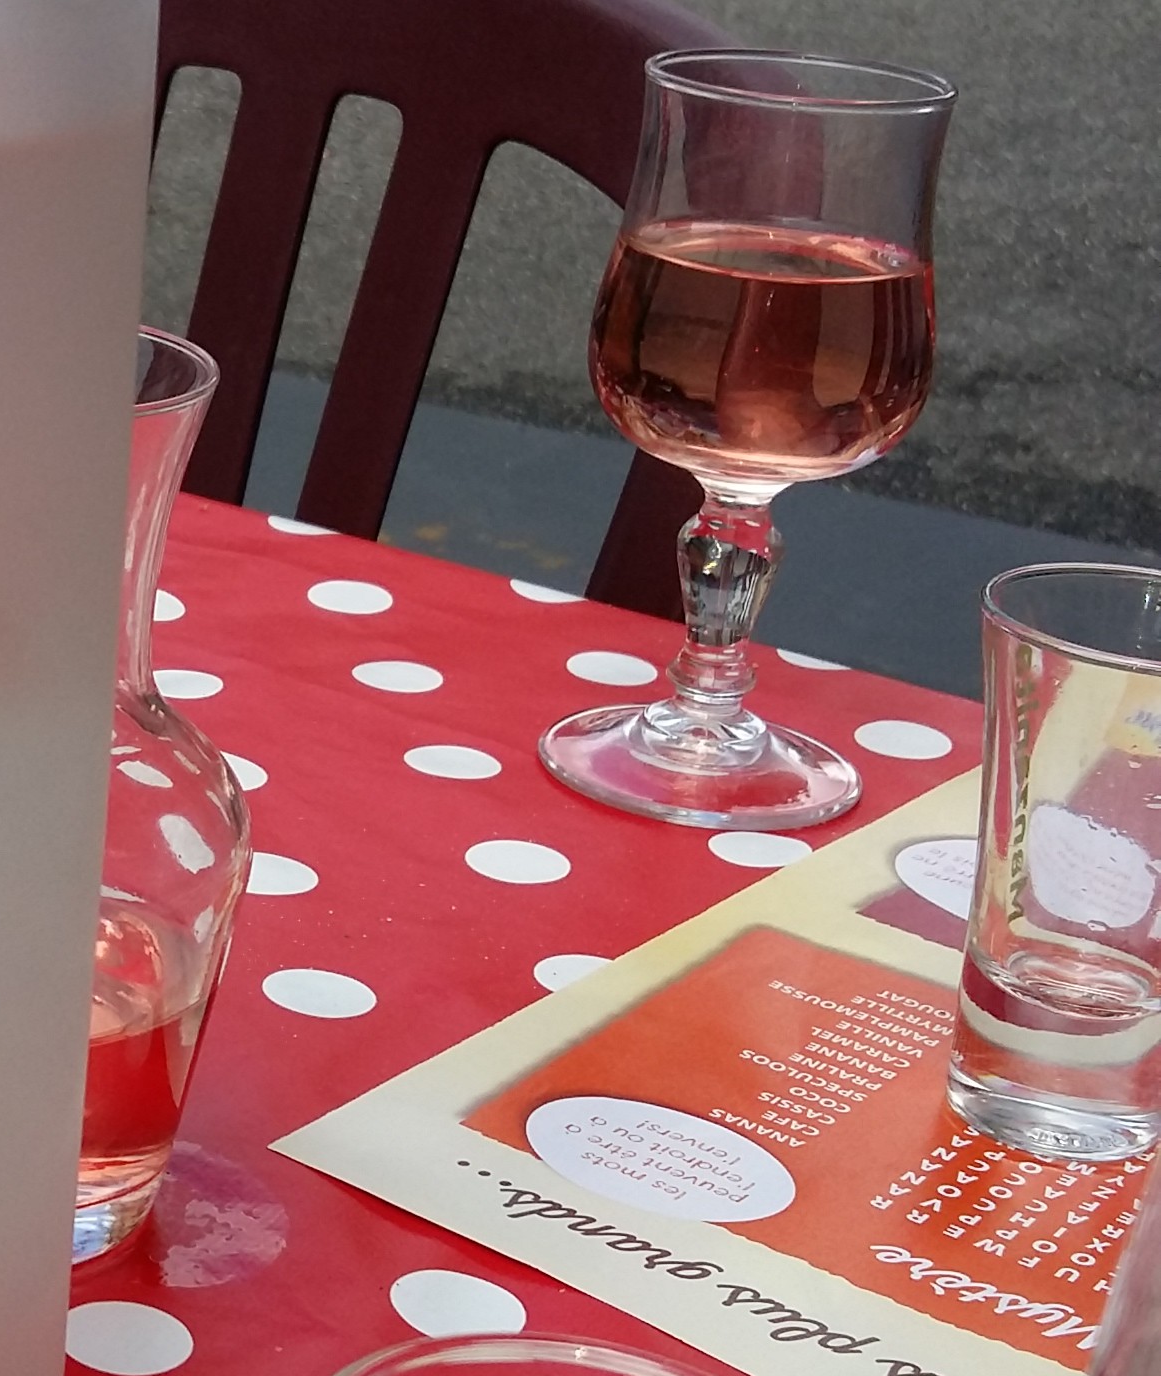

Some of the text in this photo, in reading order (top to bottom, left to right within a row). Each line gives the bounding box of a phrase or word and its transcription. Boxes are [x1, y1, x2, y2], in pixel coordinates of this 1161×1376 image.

[768, 978, 941, 1048] PAMPLEMOUSSE
[850, 994, 954, 1037] MYRTILLE
[804, 1040, 898, 1080] BANANE
[810, 1025, 911, 1069] CARAMEL
[835, 1019, 925, 1059] VANILLE
[738, 1048, 869, 1103] SPECULOOS
[788, 1051, 883, 1091] PRALINE
[757, 1090, 837, 1126] CASSIS
[788, 1086, 852, 1115] COCO
[611, 1126, 645, 1144] ou
[635, 1119, 742, 1167] l'envers!
[708, 1107, 806, 1149] ANANAS
[761, 1109, 821, 1137] CAFE
[580, 1151, 688, 1201] les mots
[642, 1156, 750, 1204] peuvent
[648, 1141, 757, 1192] l'endroit
[716, 1283, 880, 1356] plus
